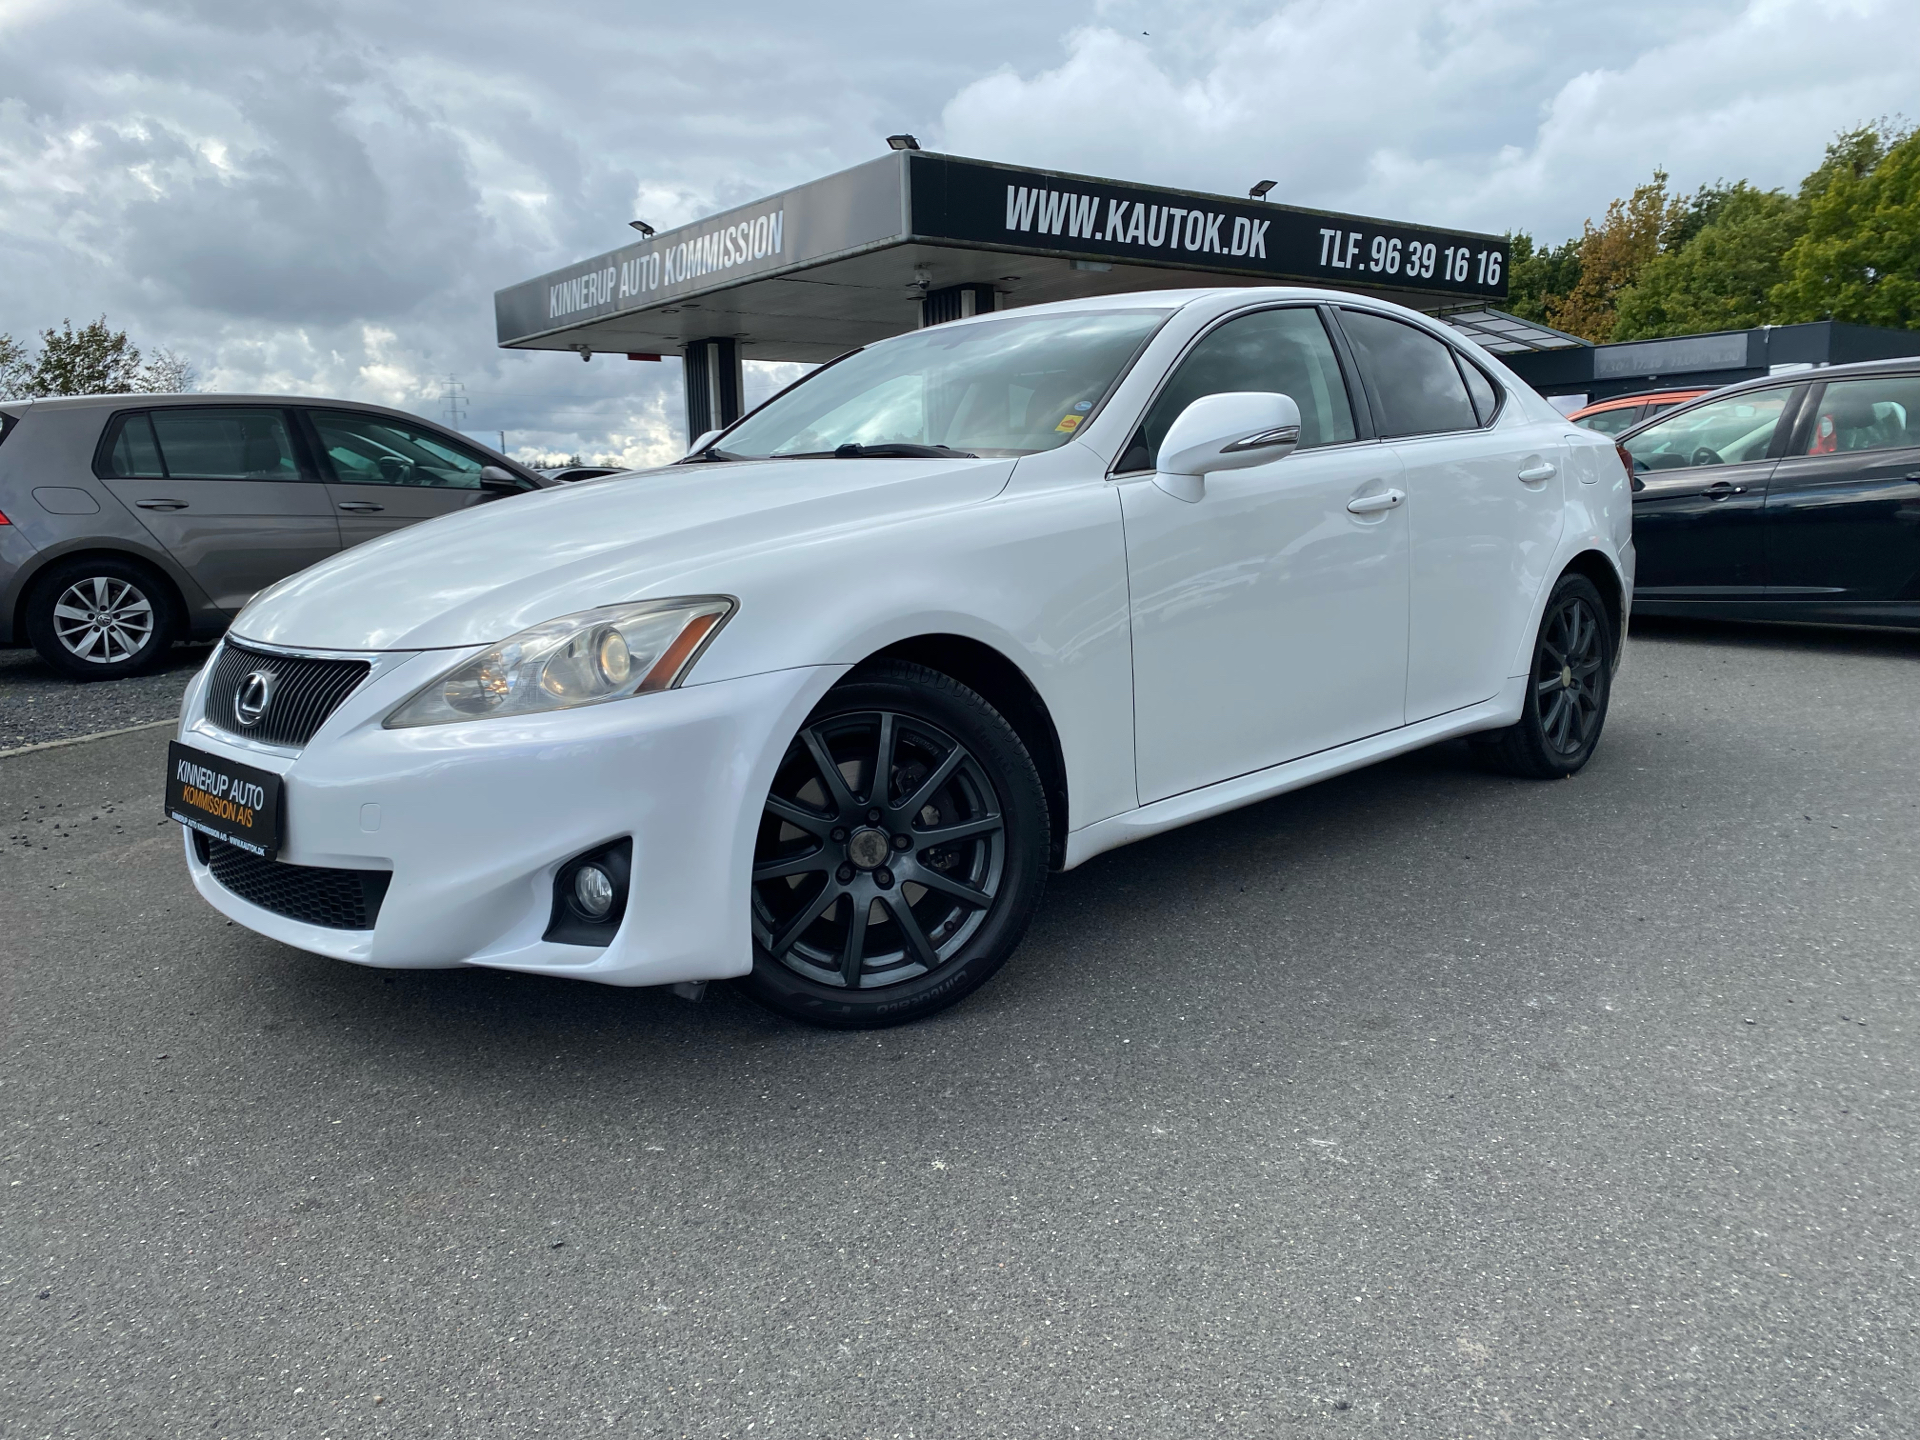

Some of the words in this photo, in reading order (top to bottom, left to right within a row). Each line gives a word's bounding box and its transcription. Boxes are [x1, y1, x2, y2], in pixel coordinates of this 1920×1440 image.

[1005, 184, 1271, 260] WWW.KAUTOK.DK
[549, 265, 617, 319] KINNERUP
[619, 250, 660, 299] AUTO
[664, 210, 784, 286] KOMMISSION
[1370, 235, 1402, 275] 96
[1406, 241, 1437, 280] 39
[1444, 245, 1469, 283] 16
[1477, 250, 1502, 287] 16
[176, 758, 229, 797] KINNERUP
[229, 778, 265, 811] AUTO
[182, 784, 237, 822] KOMMISSION
[237, 806, 254, 829] A/S
